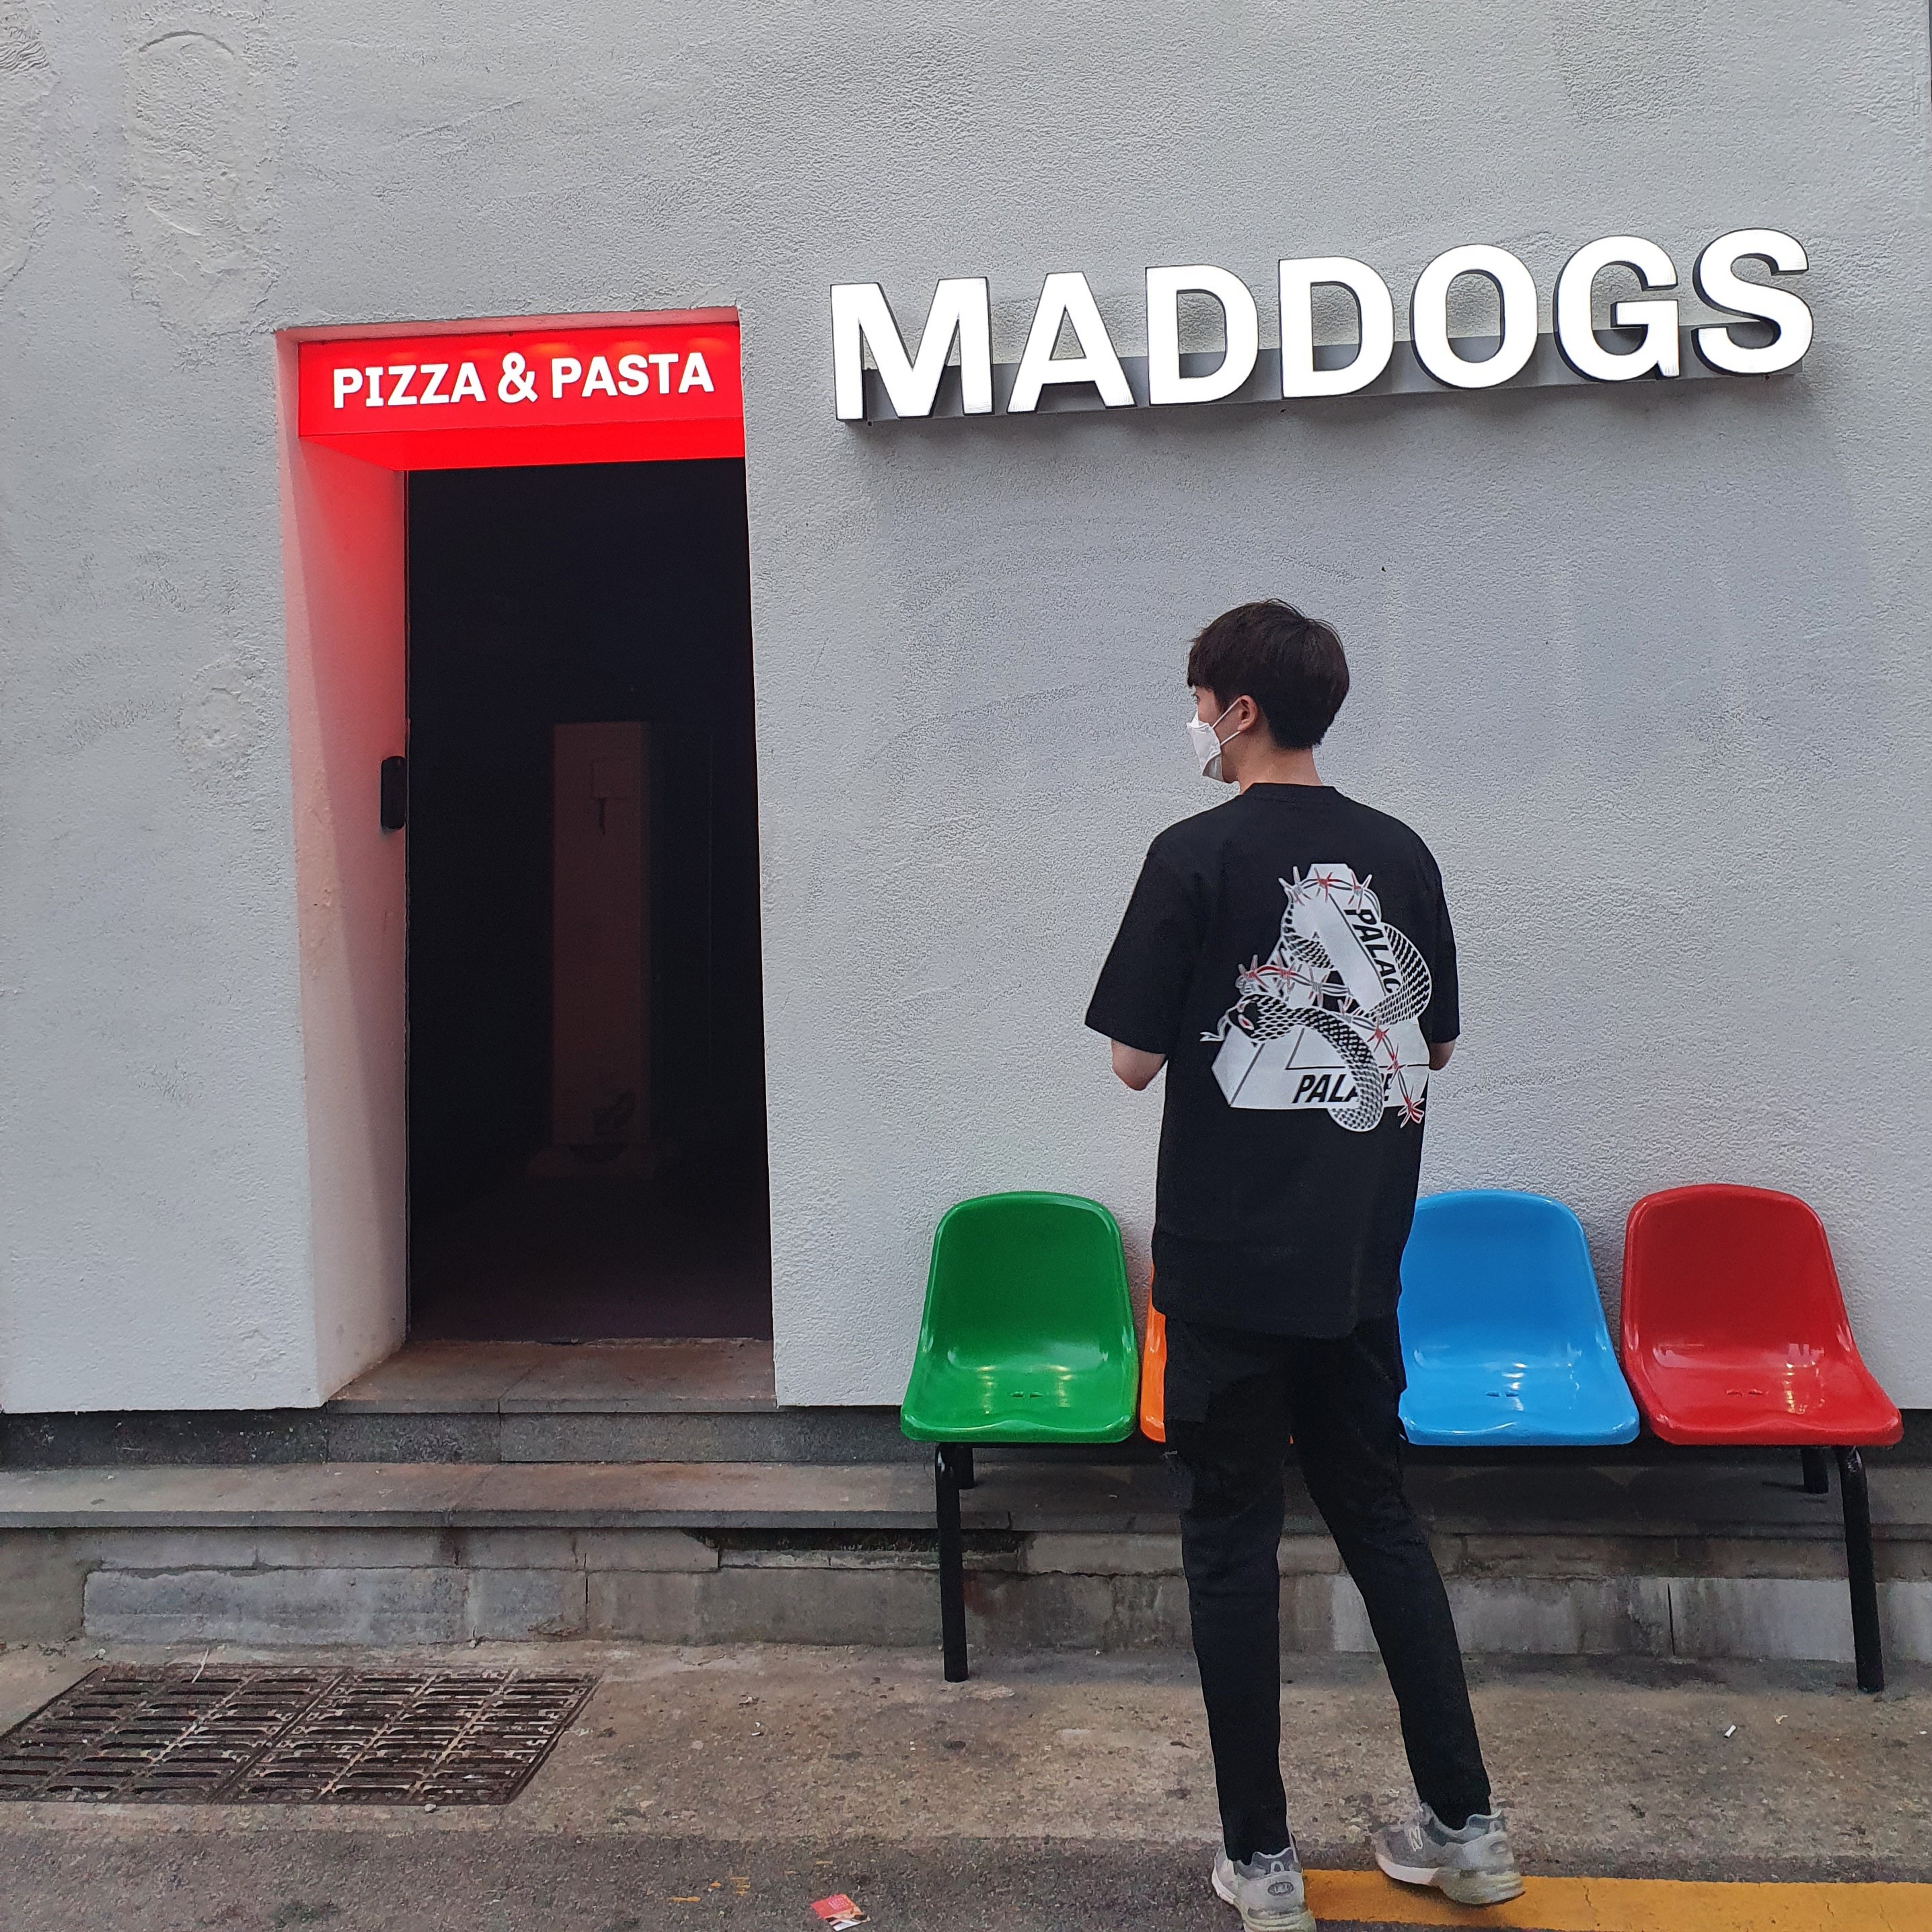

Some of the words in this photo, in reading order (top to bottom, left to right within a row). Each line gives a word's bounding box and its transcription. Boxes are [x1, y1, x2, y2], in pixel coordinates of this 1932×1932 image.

[829, 229, 1813, 420] MADDOGS
[333, 362, 486, 408] PIZZA
[498, 352, 539, 404] &
[552, 352, 715, 399] PASTA
[1343, 909, 1401, 994] PALAC
